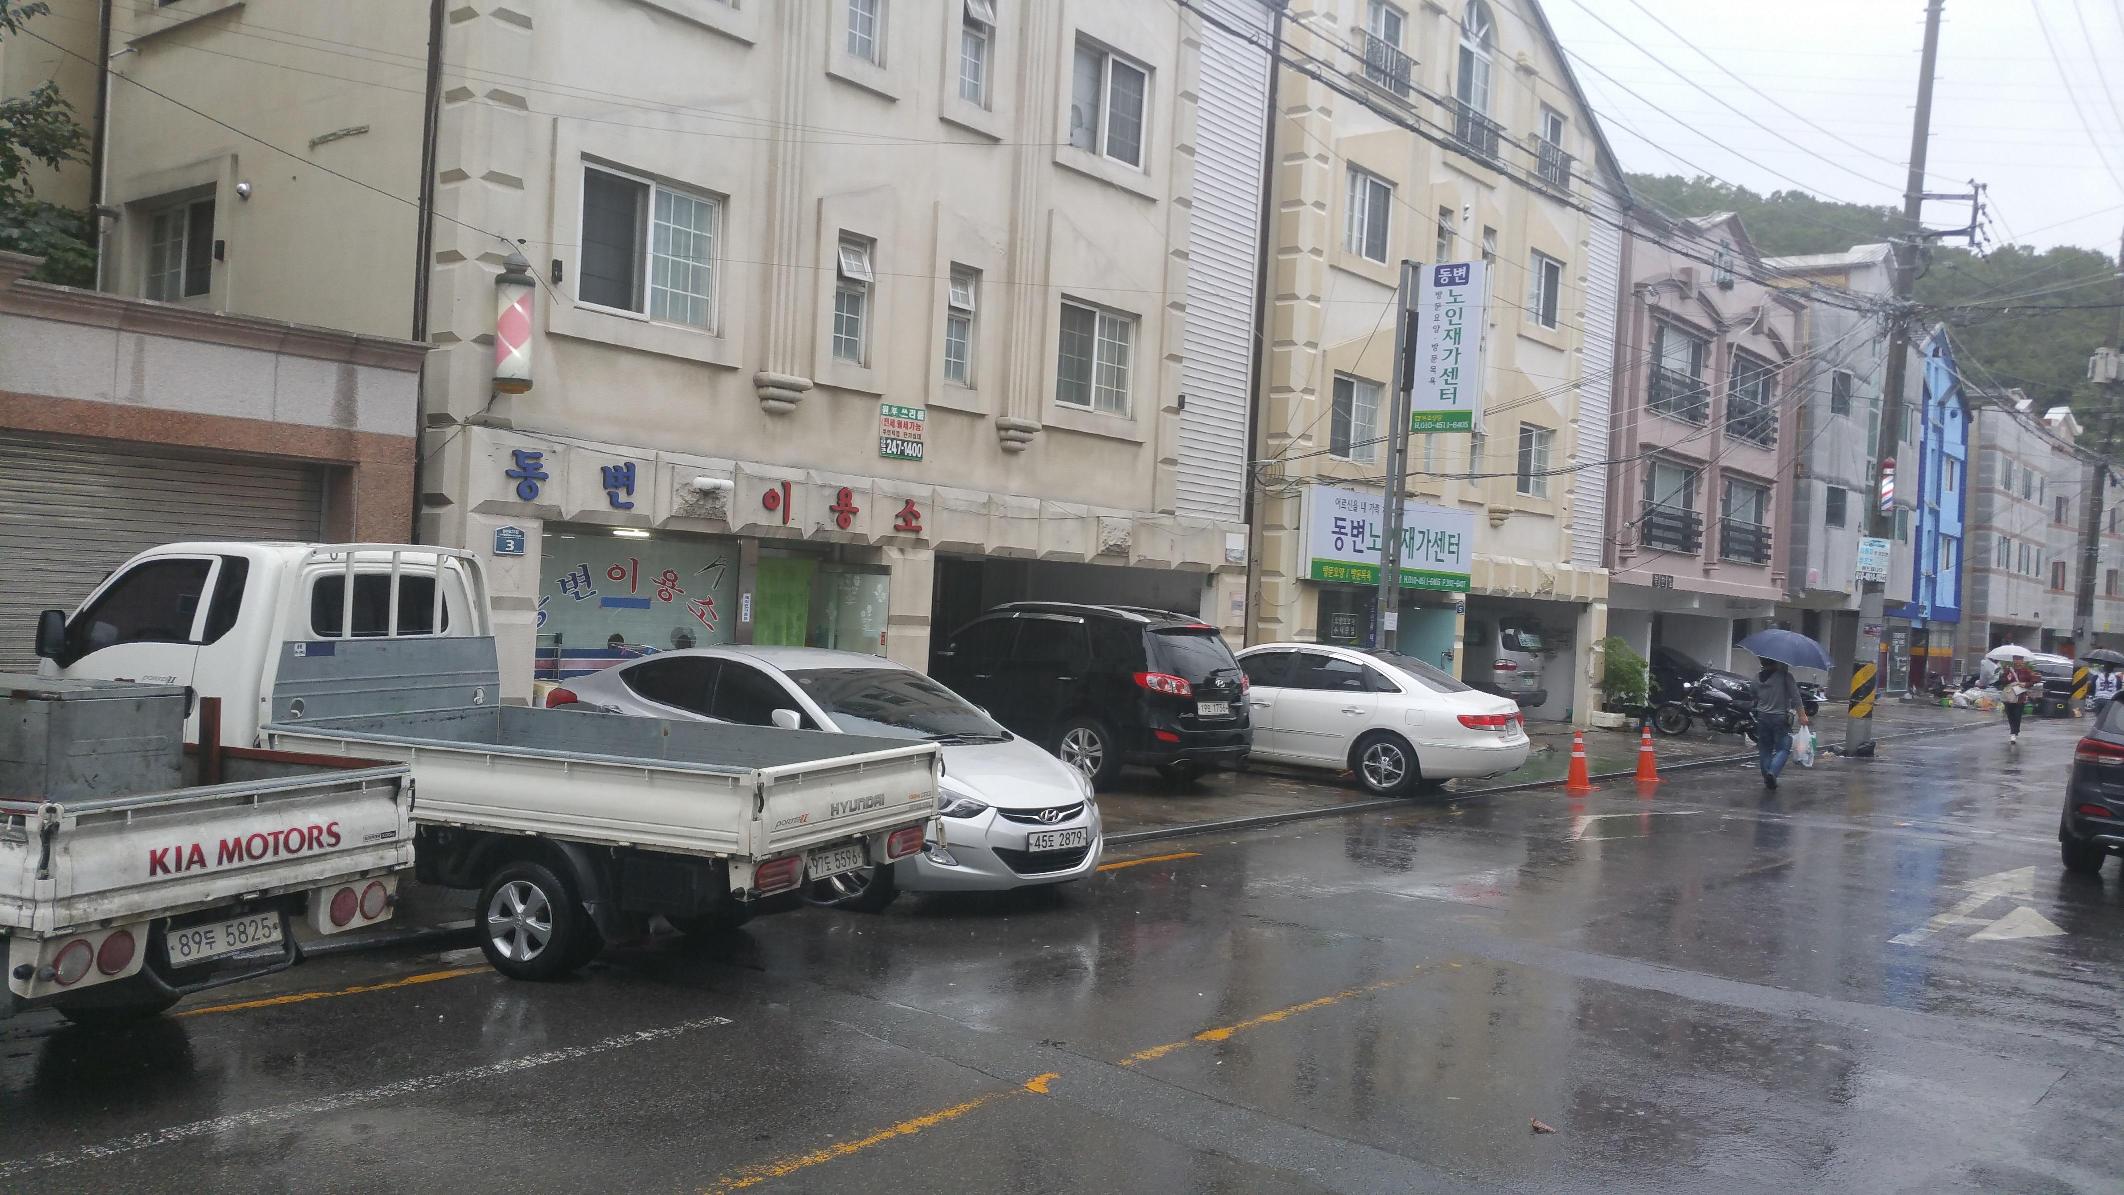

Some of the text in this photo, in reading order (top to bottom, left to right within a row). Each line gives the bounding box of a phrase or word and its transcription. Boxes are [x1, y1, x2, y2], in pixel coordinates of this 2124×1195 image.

[1438, 267, 1466, 283] 동변
[1438, 289, 1466, 405] 노인재가센터
[886, 439, 923, 458] 247-1400
[506, 448, 924, 533] 동변 이용소
[505, 539, 515, 551] 3
[830, 793, 885, 817] HYUNDAI
[149, 821, 342, 877] KIA MOTORS
[1057, 830, 1084, 848] 2879
[834, 849, 859, 869] 5596
[225, 916, 273, 949] 5825
